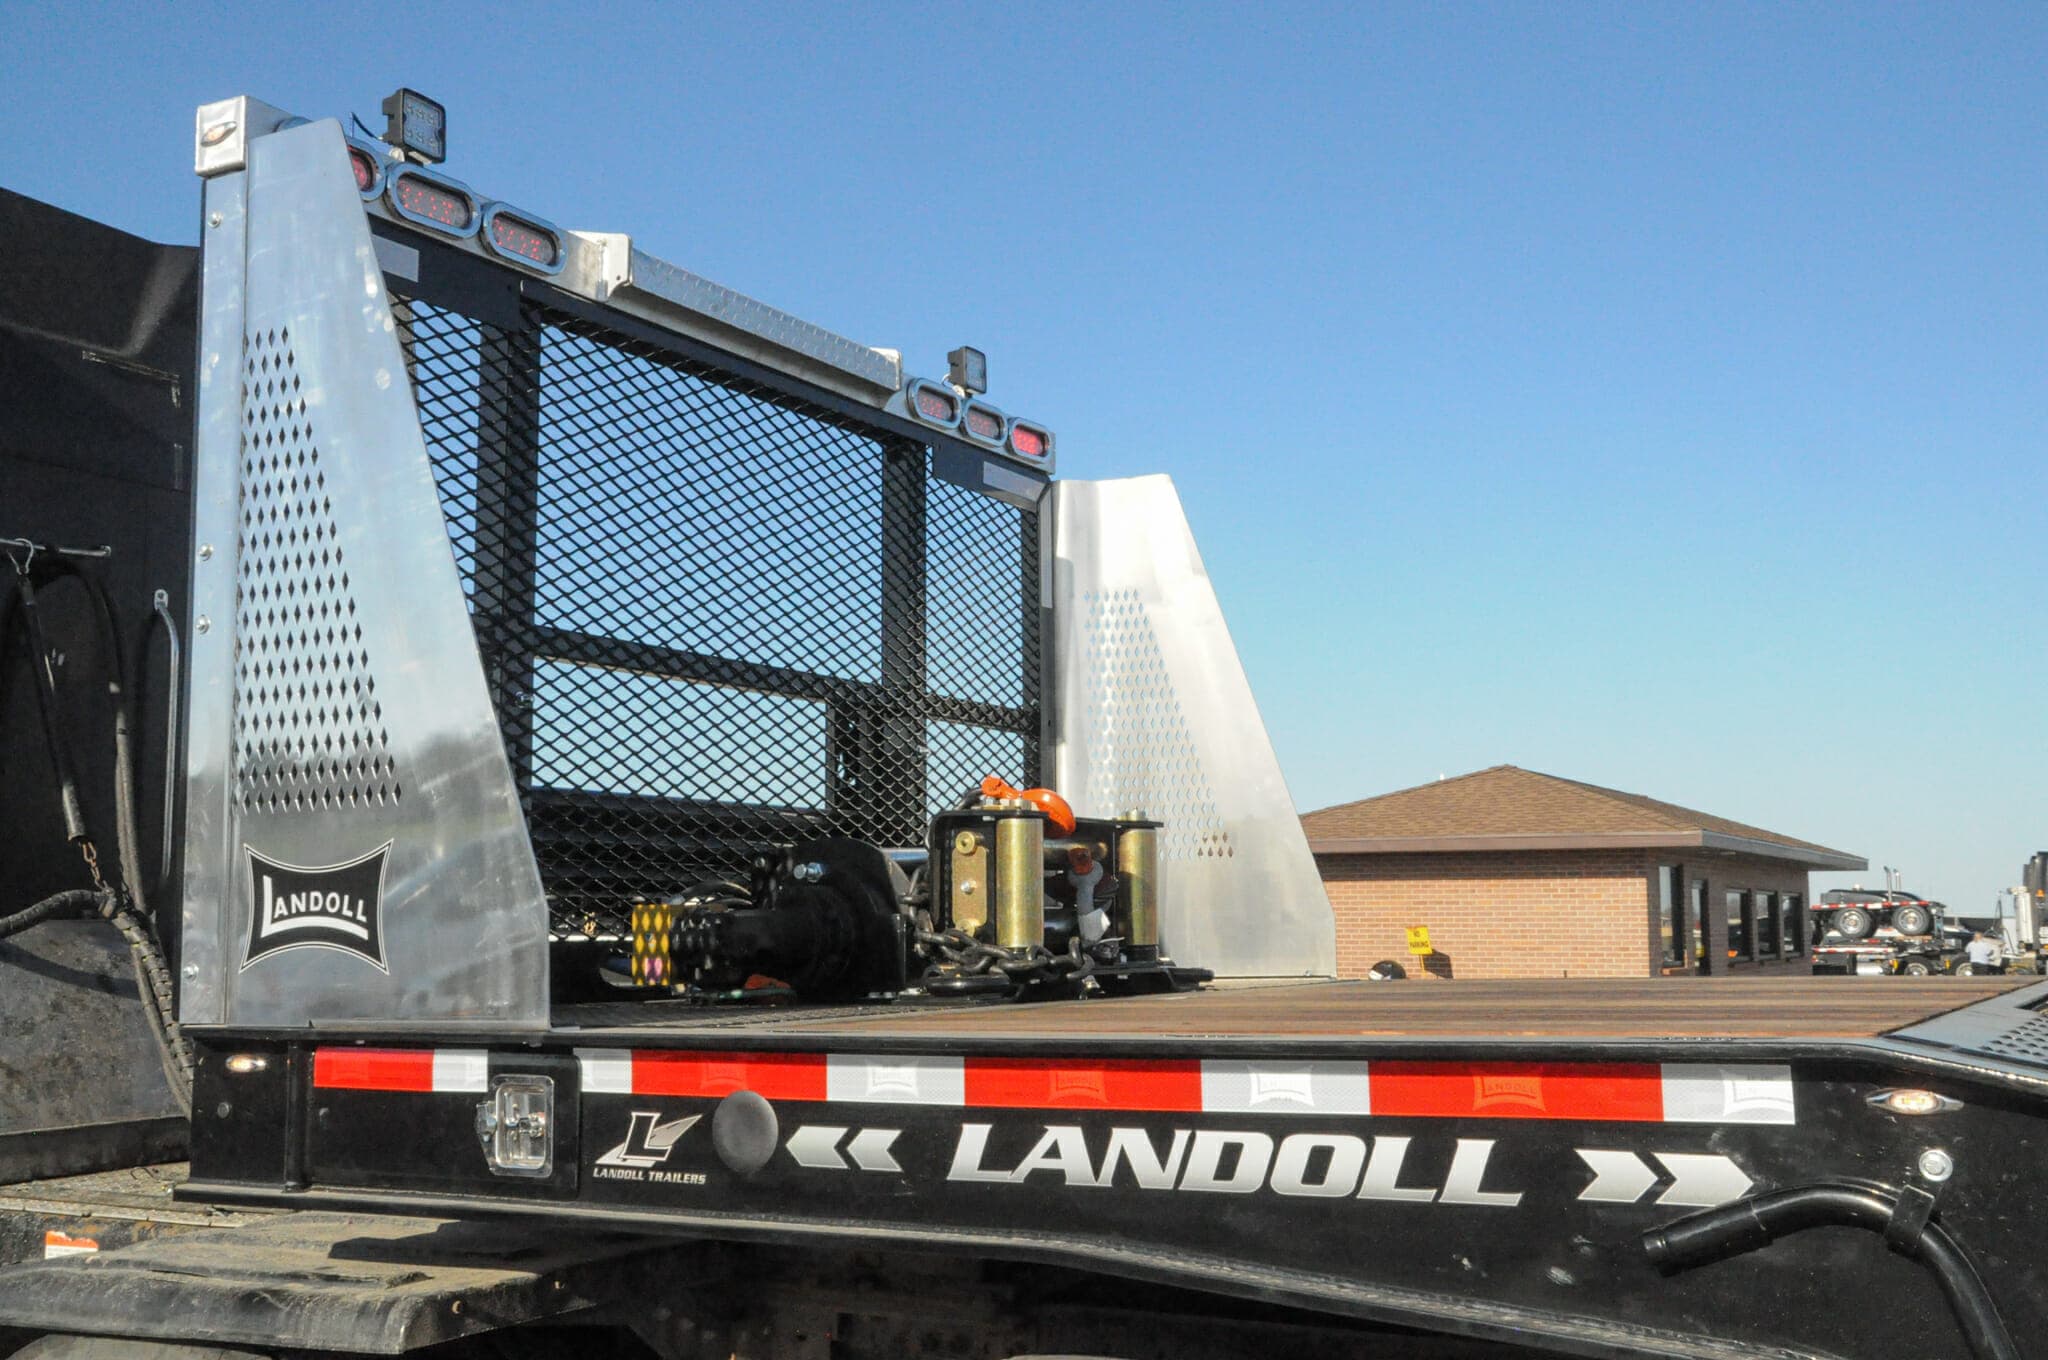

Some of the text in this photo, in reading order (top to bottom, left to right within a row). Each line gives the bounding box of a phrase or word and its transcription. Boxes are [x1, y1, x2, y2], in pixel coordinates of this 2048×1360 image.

[260, 874, 369, 941] LANDOLL
[592, 1167, 708, 1185] LANDOLL TRAILERS
[947, 1123, 1525, 1207] LANDOLL
